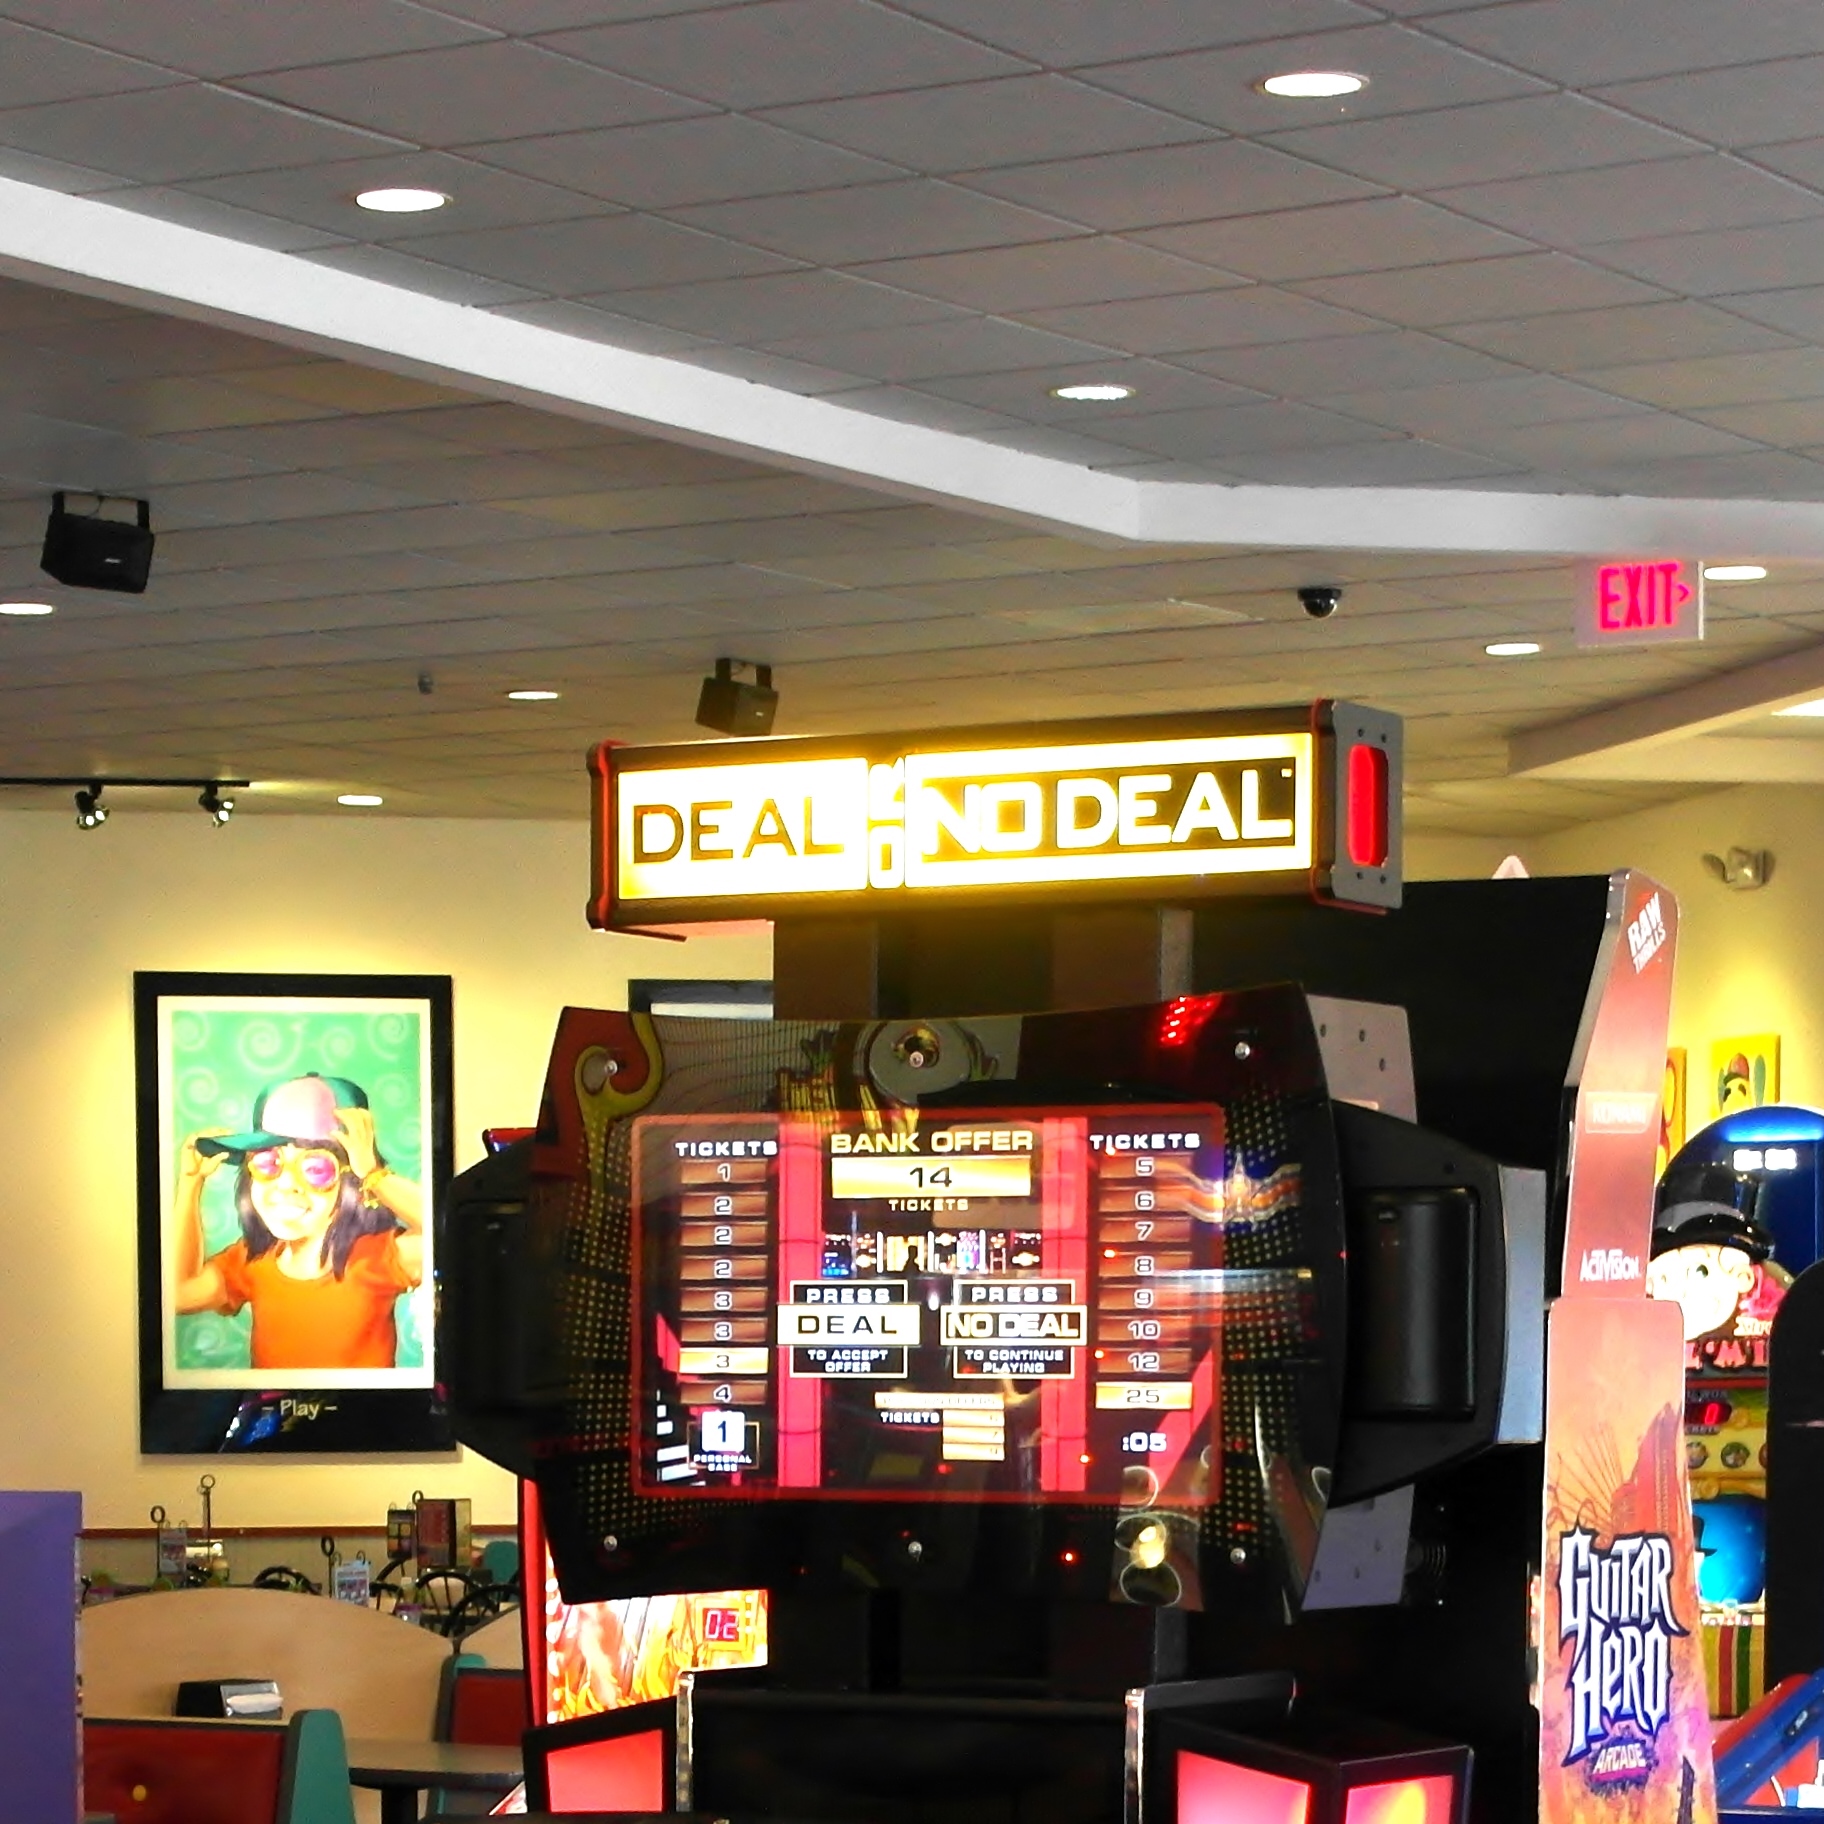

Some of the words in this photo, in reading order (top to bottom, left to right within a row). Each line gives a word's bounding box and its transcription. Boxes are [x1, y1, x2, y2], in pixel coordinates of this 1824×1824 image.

[1598, 561, 1679, 629] EXIT
[632, 796, 846, 865] DEAL
[922, 779, 1042, 855] NO
[1055, 769, 1293, 849] DEAL
[1628, 891, 1662, 955] RAW
[675, 1140, 778, 1157] TICKETS
[831, 1132, 920, 1154] BANK
[931, 1130, 1034, 1152] OFFER
[1089, 1133, 1201, 1150] TICKETS
[717, 1163, 731, 1182] 1
[1135, 1157, 1154, 1176] 5
[909, 1167, 952, 1188] 14
[714, 1196, 732, 1215] 2
[888, 1198, 969, 1212] TICKETS
[1135, 1191, 1154, 1211] 6
[714, 1226, 732, 1245] 2
[1135, 1221, 1153, 1241] 7
[714, 1259, 732, 1275] 2
[1135, 1256, 1154, 1275] 8
[714, 1292, 732, 1310] 3
[806, 1288, 890, 1304] PRESS
[971, 1286, 1058, 1302] PRESS
[1134, 1288, 1153, 1309] 9
[714, 1322, 732, 1340] 3
[797, 1315, 898, 1334] DEAL
[948, 1313, 993, 1338] NO
[998, 1313, 1079, 1338] DEAL
[1128, 1320, 1160, 1339] 10
[716, 1355, 730, 1368] 3
[807, 1350, 827, 1361] TO
[831, 1349, 888, 1361] ACCEPT
[965, 1349, 984, 1361] TO
[988, 1349, 1064, 1361] CONTINUE
[1128, 1352, 1159, 1372] 12
[825, 1361, 871, 1373] OFFER
[983, 1362, 1045, 1373] PLAYING
[714, 1385, 731, 1402] 4
[1126, 1389, 1160, 1403] 25
[280, 1400, 319, 1419] Play
[880, 1411, 940, 1424] TICKETS
[1705, 1403, 1719, 1426] 0
[717, 1420, 727, 1442] 1
[1122, 1432, 1166, 1452] :05
[693, 1454, 752, 1464] PERSONAL
[705, 1609, 738, 1640] 02
[1593, 1743, 1648, 1775] ARCADE
